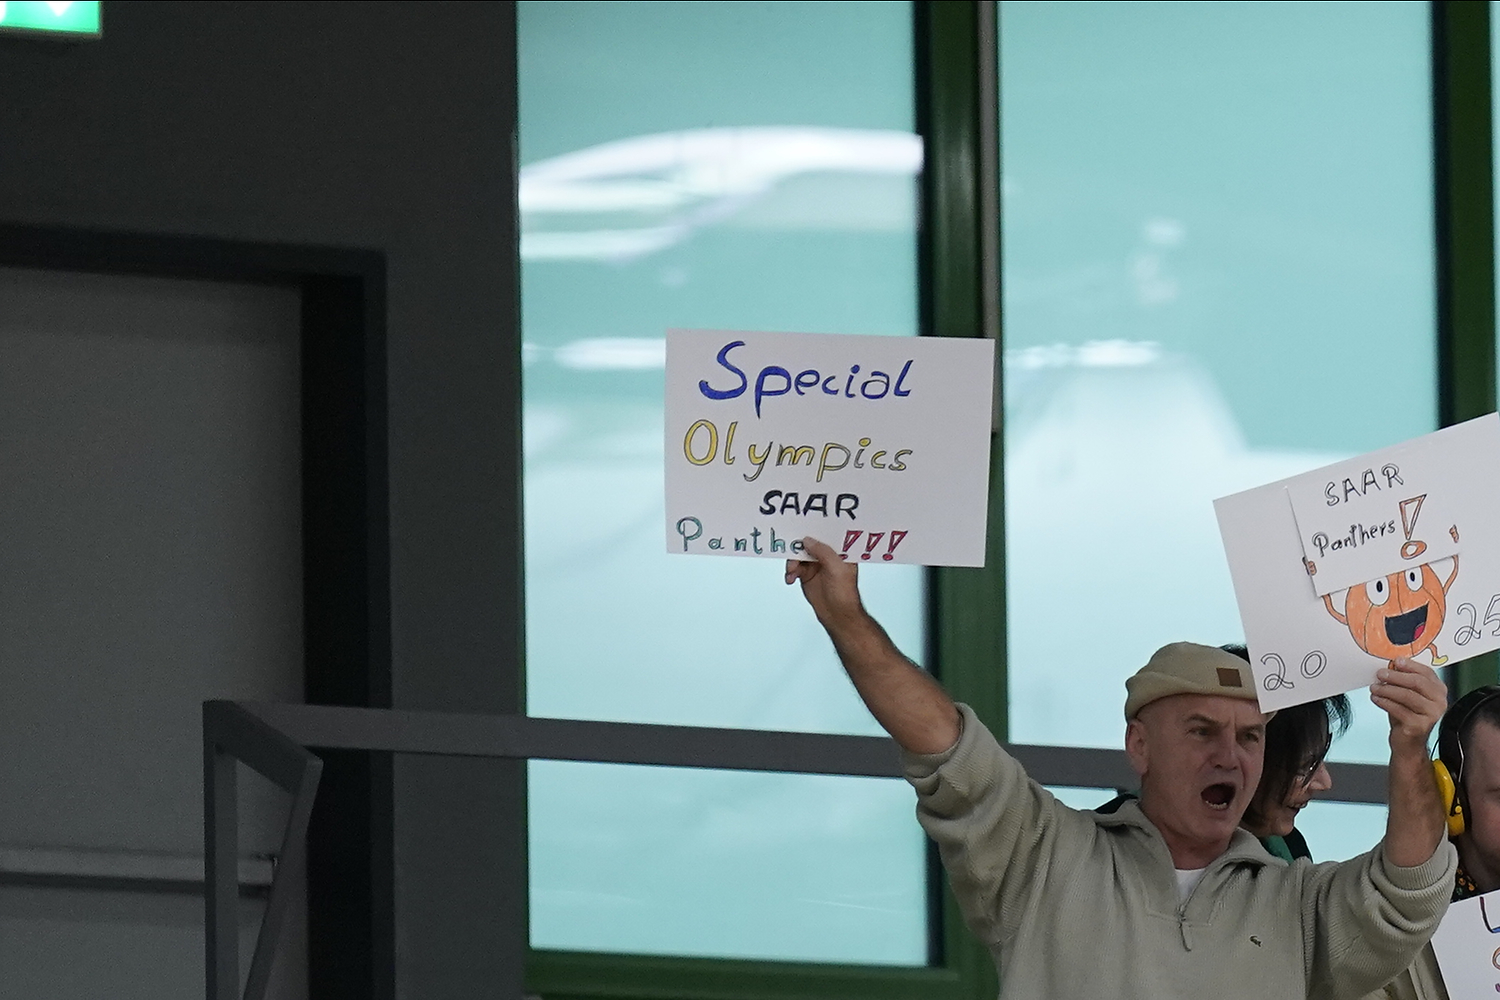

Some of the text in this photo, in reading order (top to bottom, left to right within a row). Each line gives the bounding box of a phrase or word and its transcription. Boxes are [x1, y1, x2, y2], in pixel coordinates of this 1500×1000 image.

[698, 340, 913, 419] Special
[683, 419, 913, 482] Olympics
[759, 489, 860, 520] SAAR
[1324, 463, 1404, 507] SAAR
[1260, 650, 1328, 691] 20
